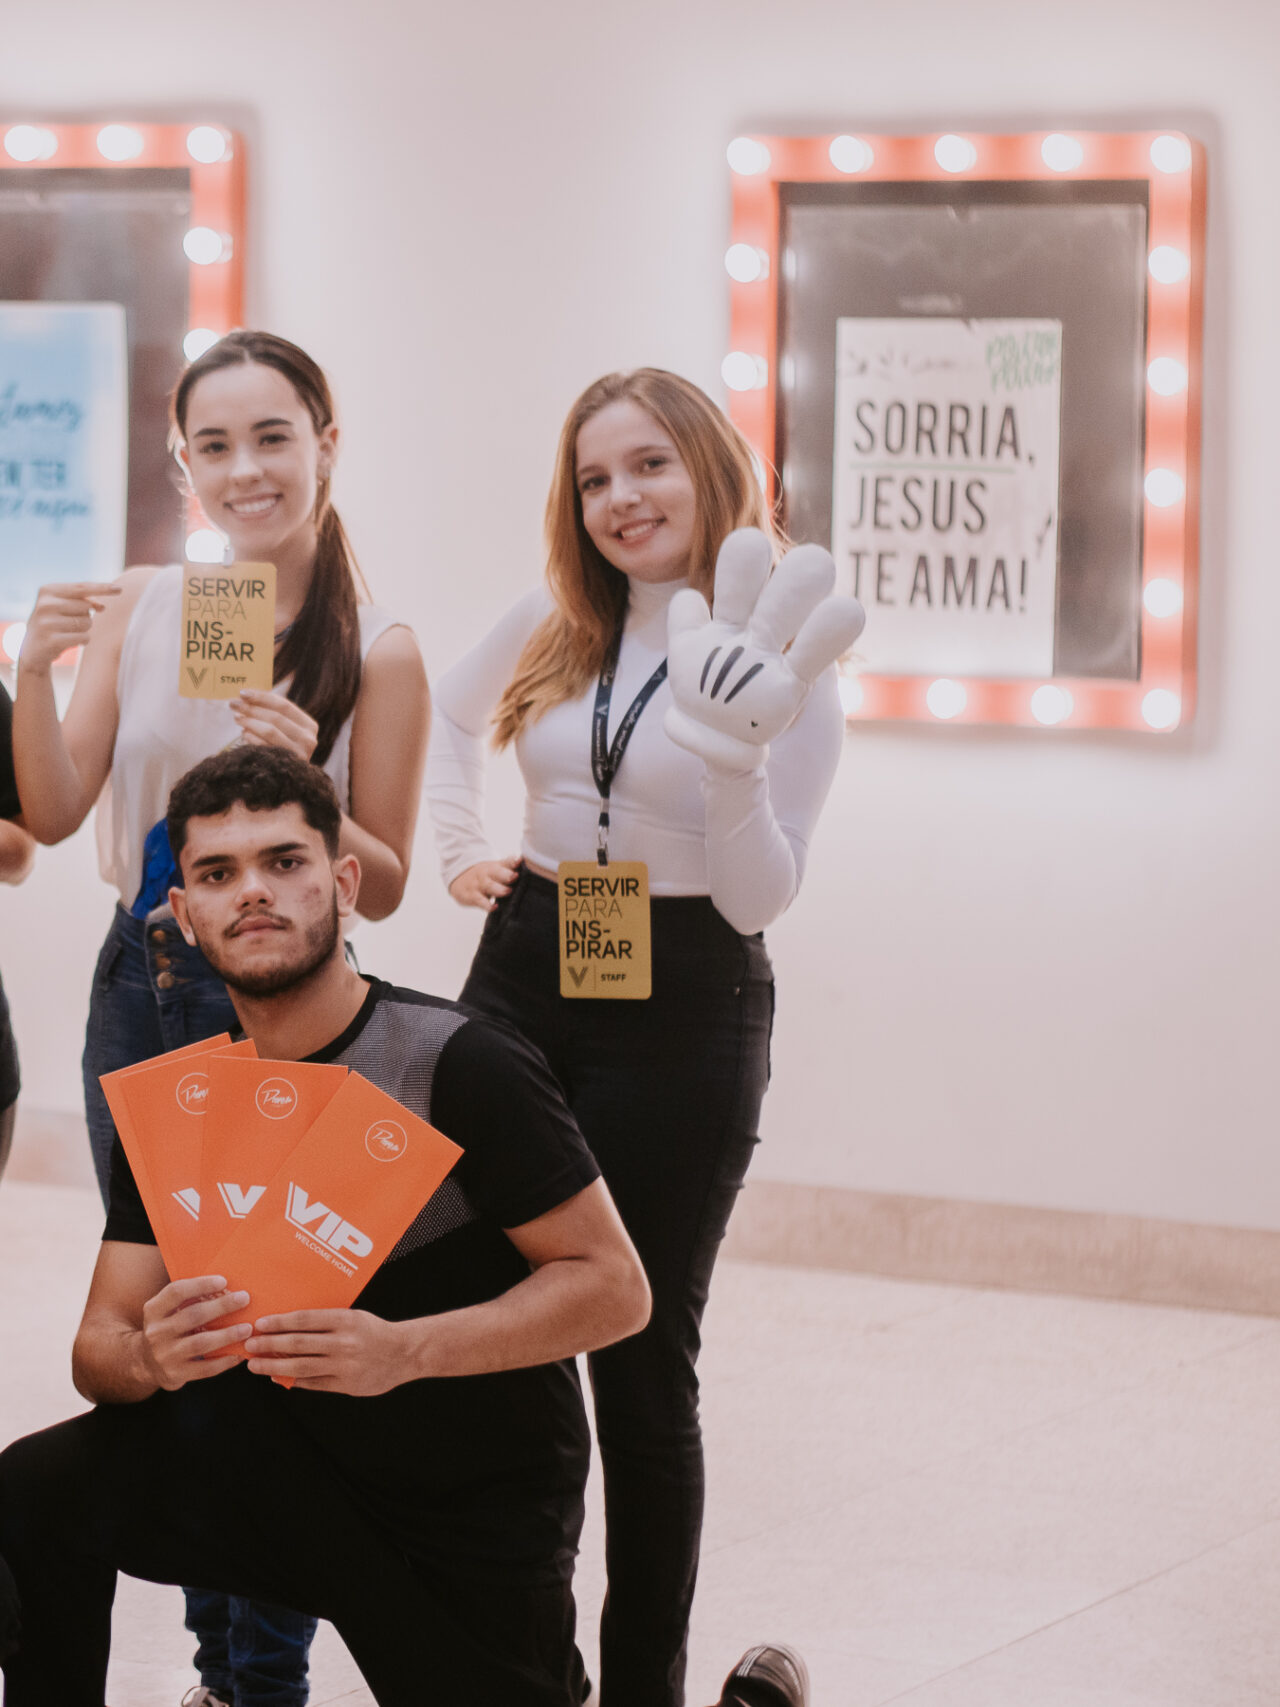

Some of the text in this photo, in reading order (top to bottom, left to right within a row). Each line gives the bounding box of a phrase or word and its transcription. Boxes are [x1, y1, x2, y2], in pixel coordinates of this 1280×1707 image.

[854, 401, 1035, 465] SORRIA,
[849, 475, 988, 535] JESUS
[187, 576, 266, 599] SERVIR
[848, 550, 1027, 613] TE AMA!
[186, 598, 248, 620] PARA
[186, 620, 234, 641] INS-
[186, 640, 255, 662] PIRAR
[220, 676, 247, 684] STAFF
[563, 877, 641, 897] SERVIR
[564, 898, 624, 919] PARA
[565, 920, 611, 940] INS-
[565, 940, 634, 960] PIRAR
[600, 974, 627, 983] STAFF
[285, 1182, 374, 1258] VIP
[294, 1230, 355, 1279] WELCOME HOME
